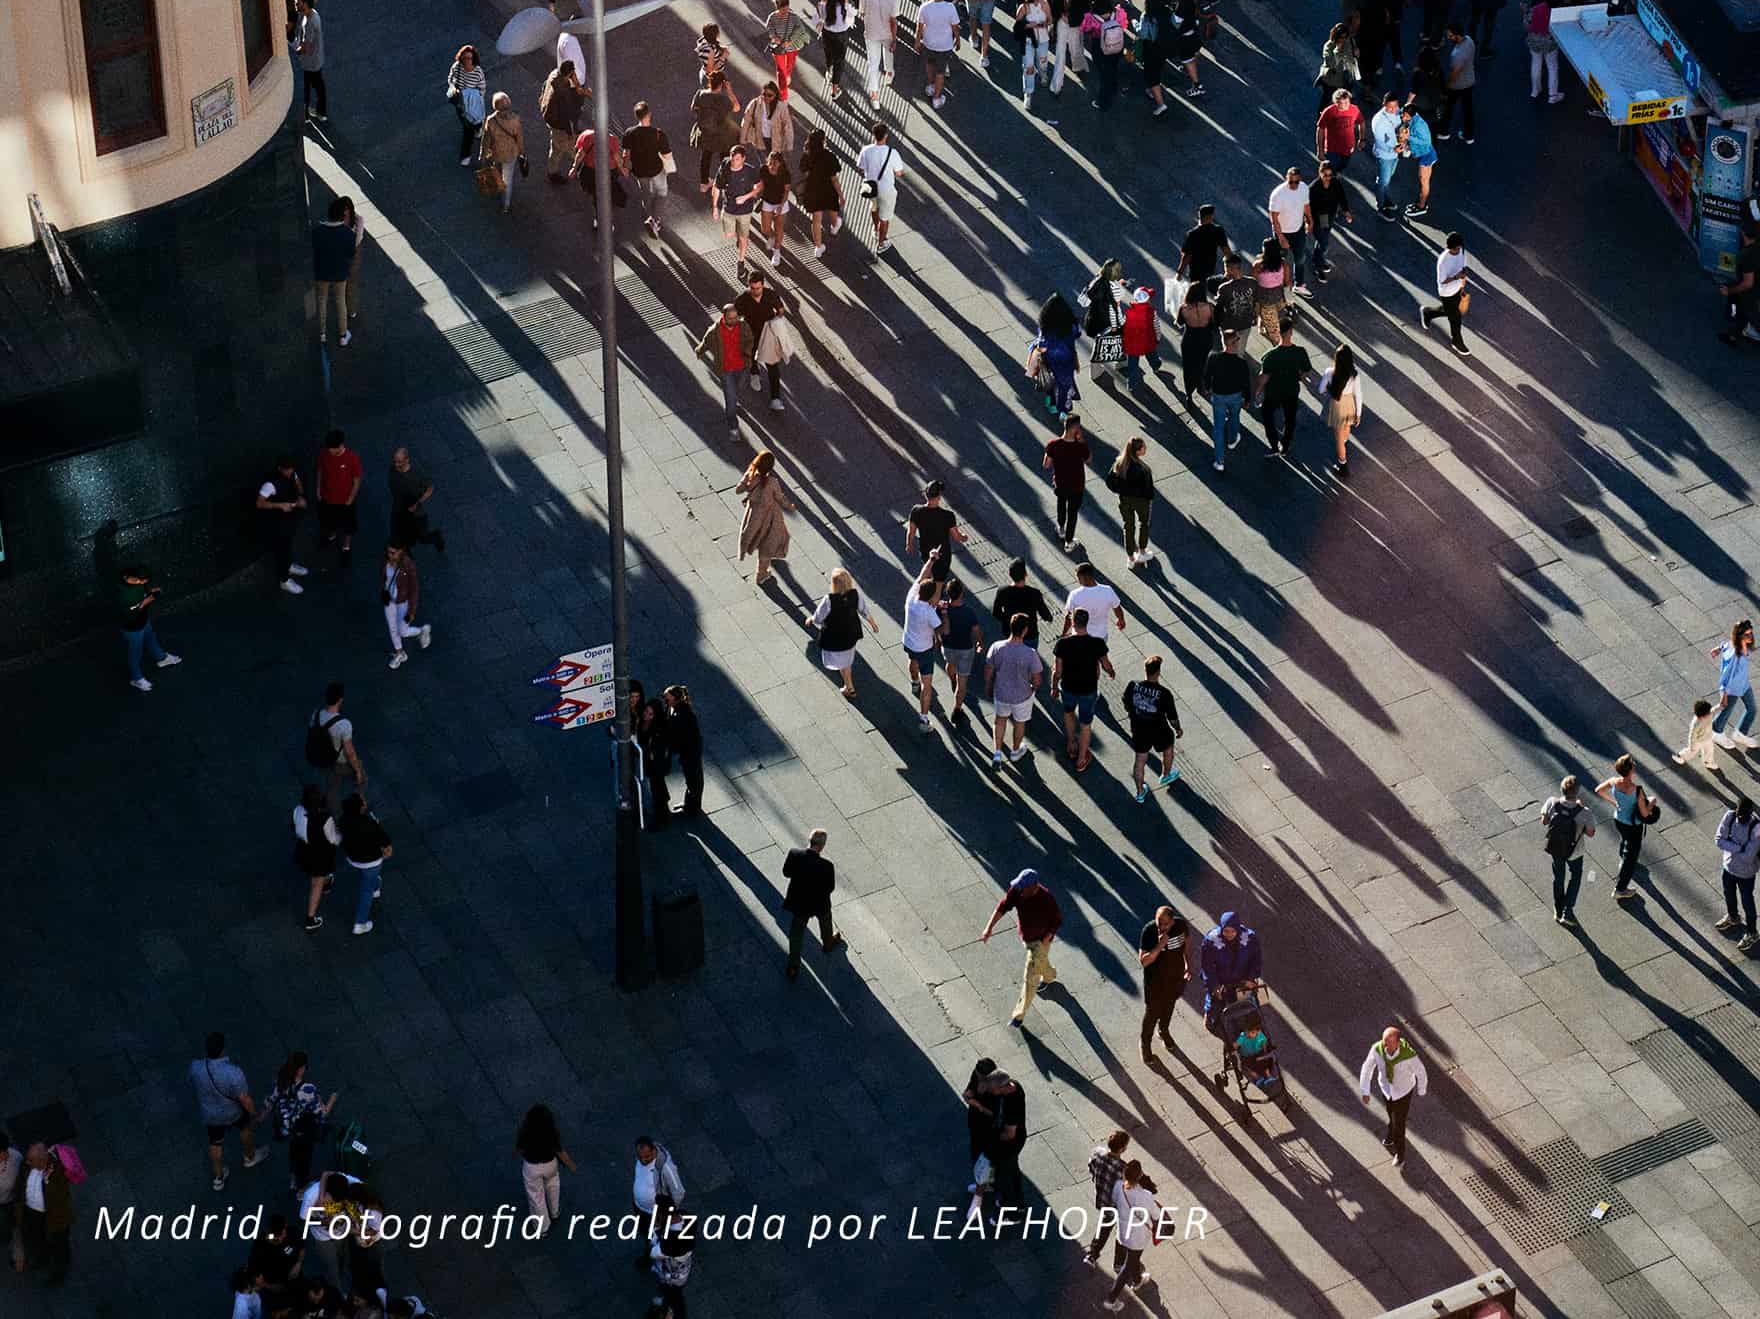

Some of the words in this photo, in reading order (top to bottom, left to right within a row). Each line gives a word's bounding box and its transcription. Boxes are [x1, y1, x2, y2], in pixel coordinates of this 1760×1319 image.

[1631, 101, 1667, 112] BEBIDAS
[198, 118, 220, 134] PLAZA
[201, 118, 233, 141] CALLAO
[1100, 345, 1109, 353] IS
[1110, 344, 1123, 353] MY
[1099, 352, 1124, 361] STYLE
[584, 647, 612, 659] Ópera
[599, 683, 614, 693] Sol
[1135, 682, 1163, 699] ROME
